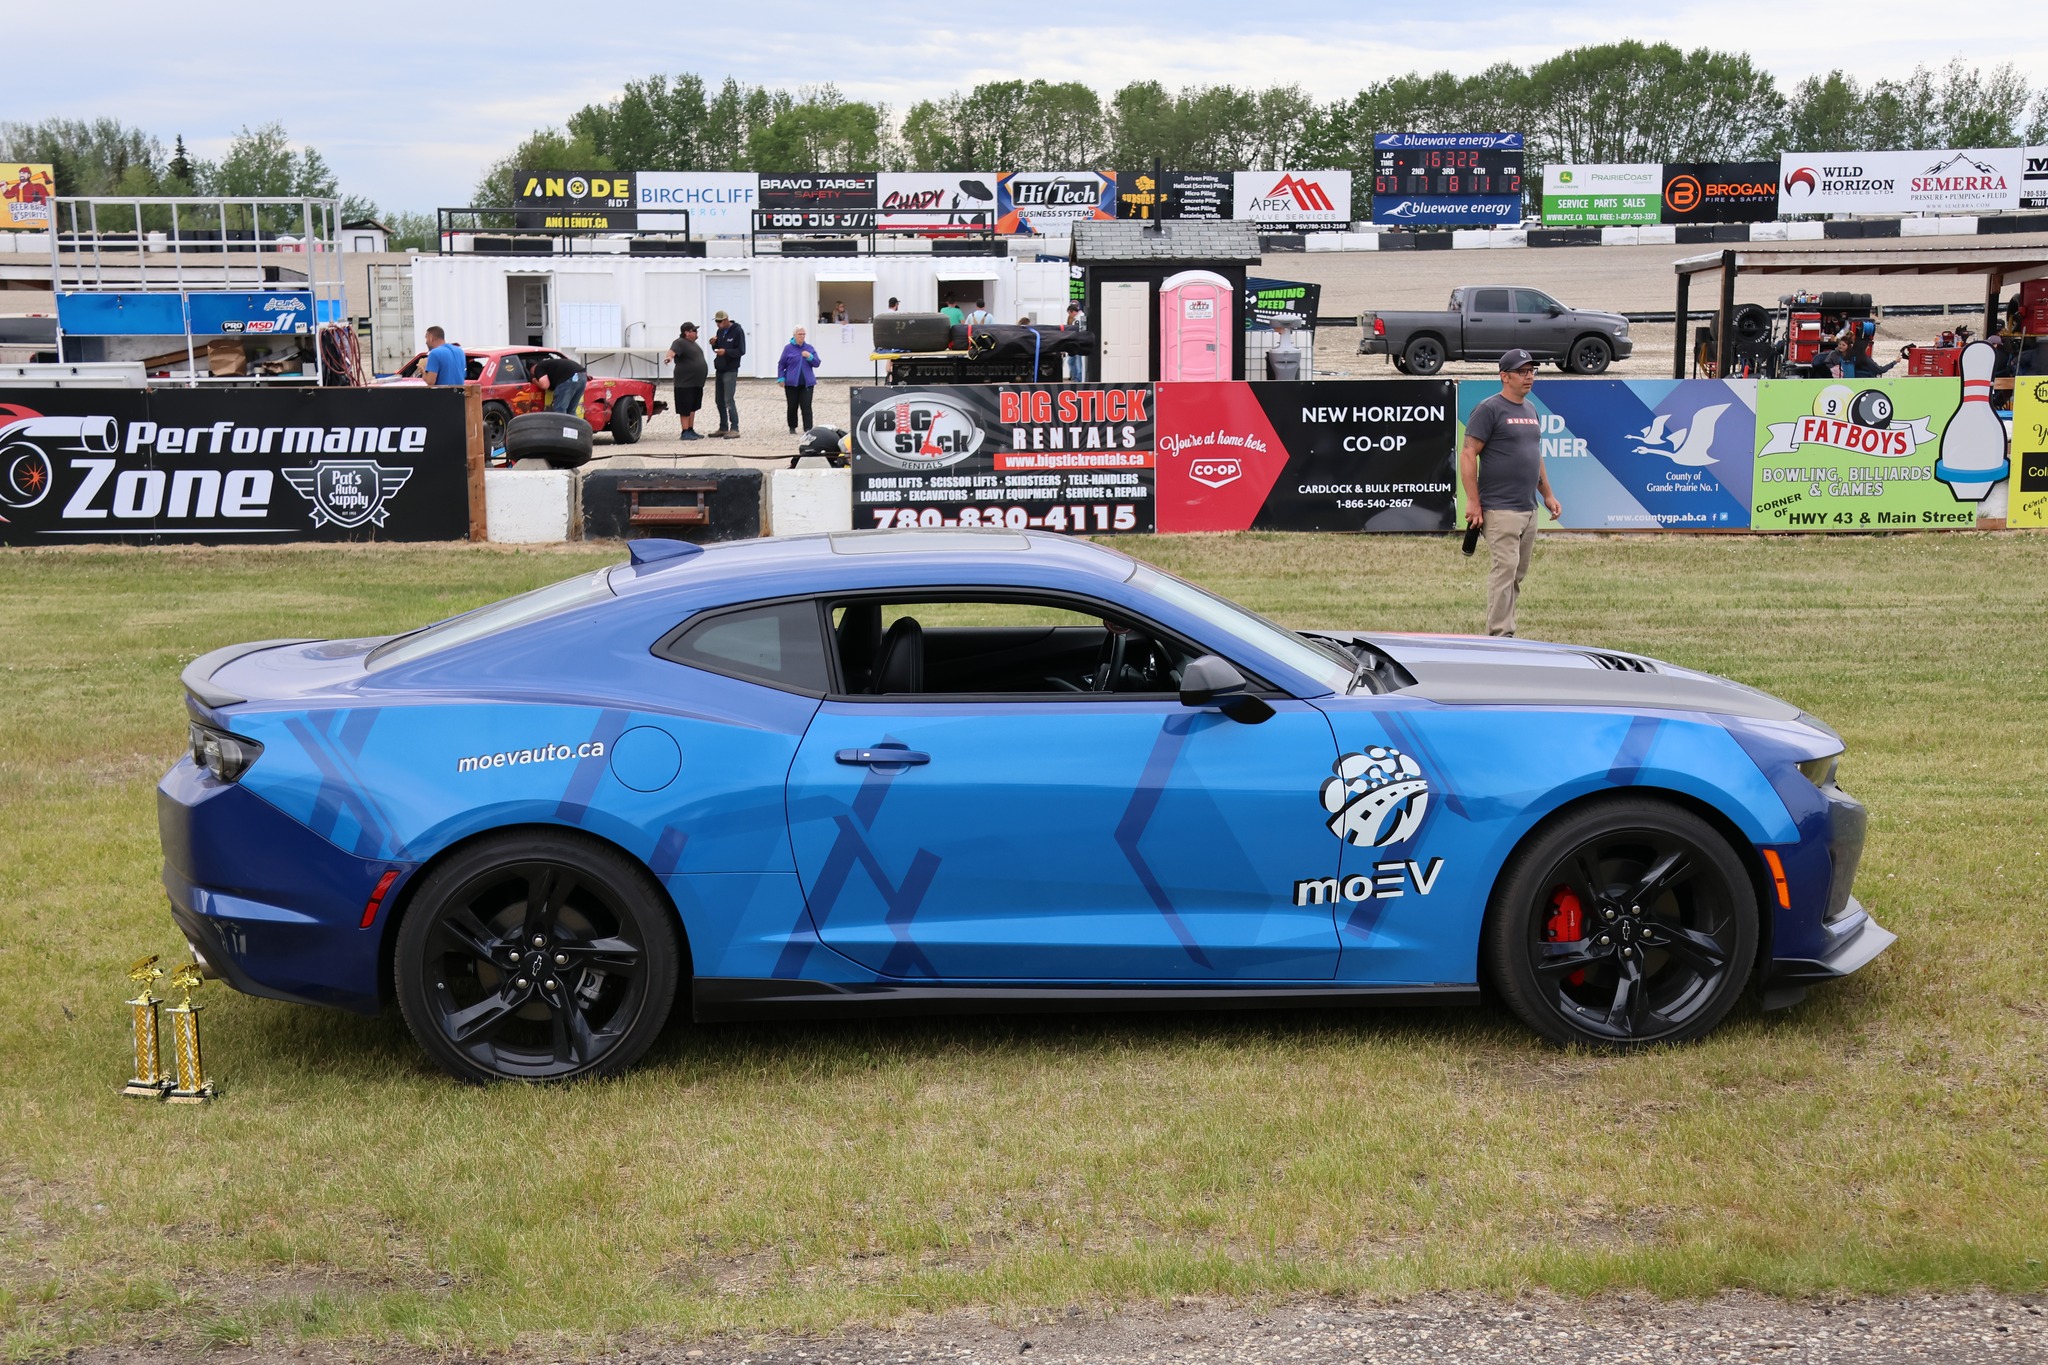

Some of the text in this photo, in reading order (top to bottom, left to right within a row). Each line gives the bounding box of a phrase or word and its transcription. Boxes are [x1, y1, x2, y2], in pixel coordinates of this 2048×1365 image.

[1404, 135, 1497, 148] bluewave energy
[1382, 168, 1394, 176] 1ST
[1412, 168, 1425, 176] 2ND
[1442, 168, 1456, 176] 3RD
[1473, 168, 1486, 176] 4TH
[1823, 167, 1863, 178] WILD
[760, 179, 875, 189] BRAVO TARGET
[1203, 175, 1219, 183] Piling
[1377, 176, 1398, 192] 67
[1420, 176, 1428, 191] 7
[1450, 176, 1459, 192] 8
[1511, 176, 1521, 191] 2
[1822, 179, 1895, 191] HORIZON
[1910, 175, 2008, 192] SEMERRA
[1053, 183, 1097, 204] Tech
[1214, 183, 1229, 191] Piling
[1706, 183, 1776, 196] BROGAN
[641, 188, 754, 203] BIRCHCLIFF
[794, 190, 842, 198] SAFETY
[30, 203, 47, 211] BRO
[607, 199, 629, 208] NDT
[1201, 205, 1217, 213] Piling
[1249, 197, 1290, 211] APEX
[1412, 203, 1511, 215] bluewave energy
[1557, 198, 1646, 209] SERVICE PARTS SALES
[2030, 199, 2045, 207] 7701
[1018, 210, 1057, 218] BUSINESS
[1258, 287, 1306, 299] WINNING
[1257, 300, 1285, 309] SPEED
[248, 321, 273, 329] MSD
[273, 312, 296, 331] 11
[1000, 389, 1148, 423] BIG STICK
[1878, 401, 1887, 415] 8
[1302, 406, 1445, 423] NEW HORIZON
[125, 421, 428, 454] Performance
[1012, 426, 1137, 450] RENTALS
[1160, 429, 1267, 457] You're at home here.
[1803, 419, 1907, 455] FATBOYS
[1343, 436, 1407, 452] CO-OP
[902, 461, 944, 470] RENTALS
[1005, 453, 1145, 468] www.bigstickrentals.ca
[332, 470, 362, 485] Pat's
[1665, 471, 1702, 482] County of
[1762, 466, 1932, 482] BOWLING, BILLIARDS
[868, 474, 1139, 489] BOOM LIFTS SCISSOR LIFTS SKIDSTEERS TELE-HANDLERS
[1646, 482, 1719, 492] Grande Prairie No. 1
[62, 458, 275, 519] Zone
[335, 484, 358, 494] Auto
[860, 486, 1148, 502] LOADERS EXCAVATORS HEAVY EQUIPMENT SERVICE & REPAIR
[1298, 483, 1451, 494] CARDLOCK & BULK PETROLEUM
[1808, 482, 1884, 497] & GAMES
[328, 492, 369, 509] Supply
[1336, 499, 1413, 508] 1-866-540-2667
[1756, 493, 1802, 513] CORNER
[872, 504, 1137, 531] 780-830-4115
[1607, 513, 1707, 523] www.countygp.ab.ca
[1774, 508, 1789, 518] OF
[1789, 510, 1974, 524] HWY 43 & Main Street
[457, 742, 605, 772] moevauto.ca
